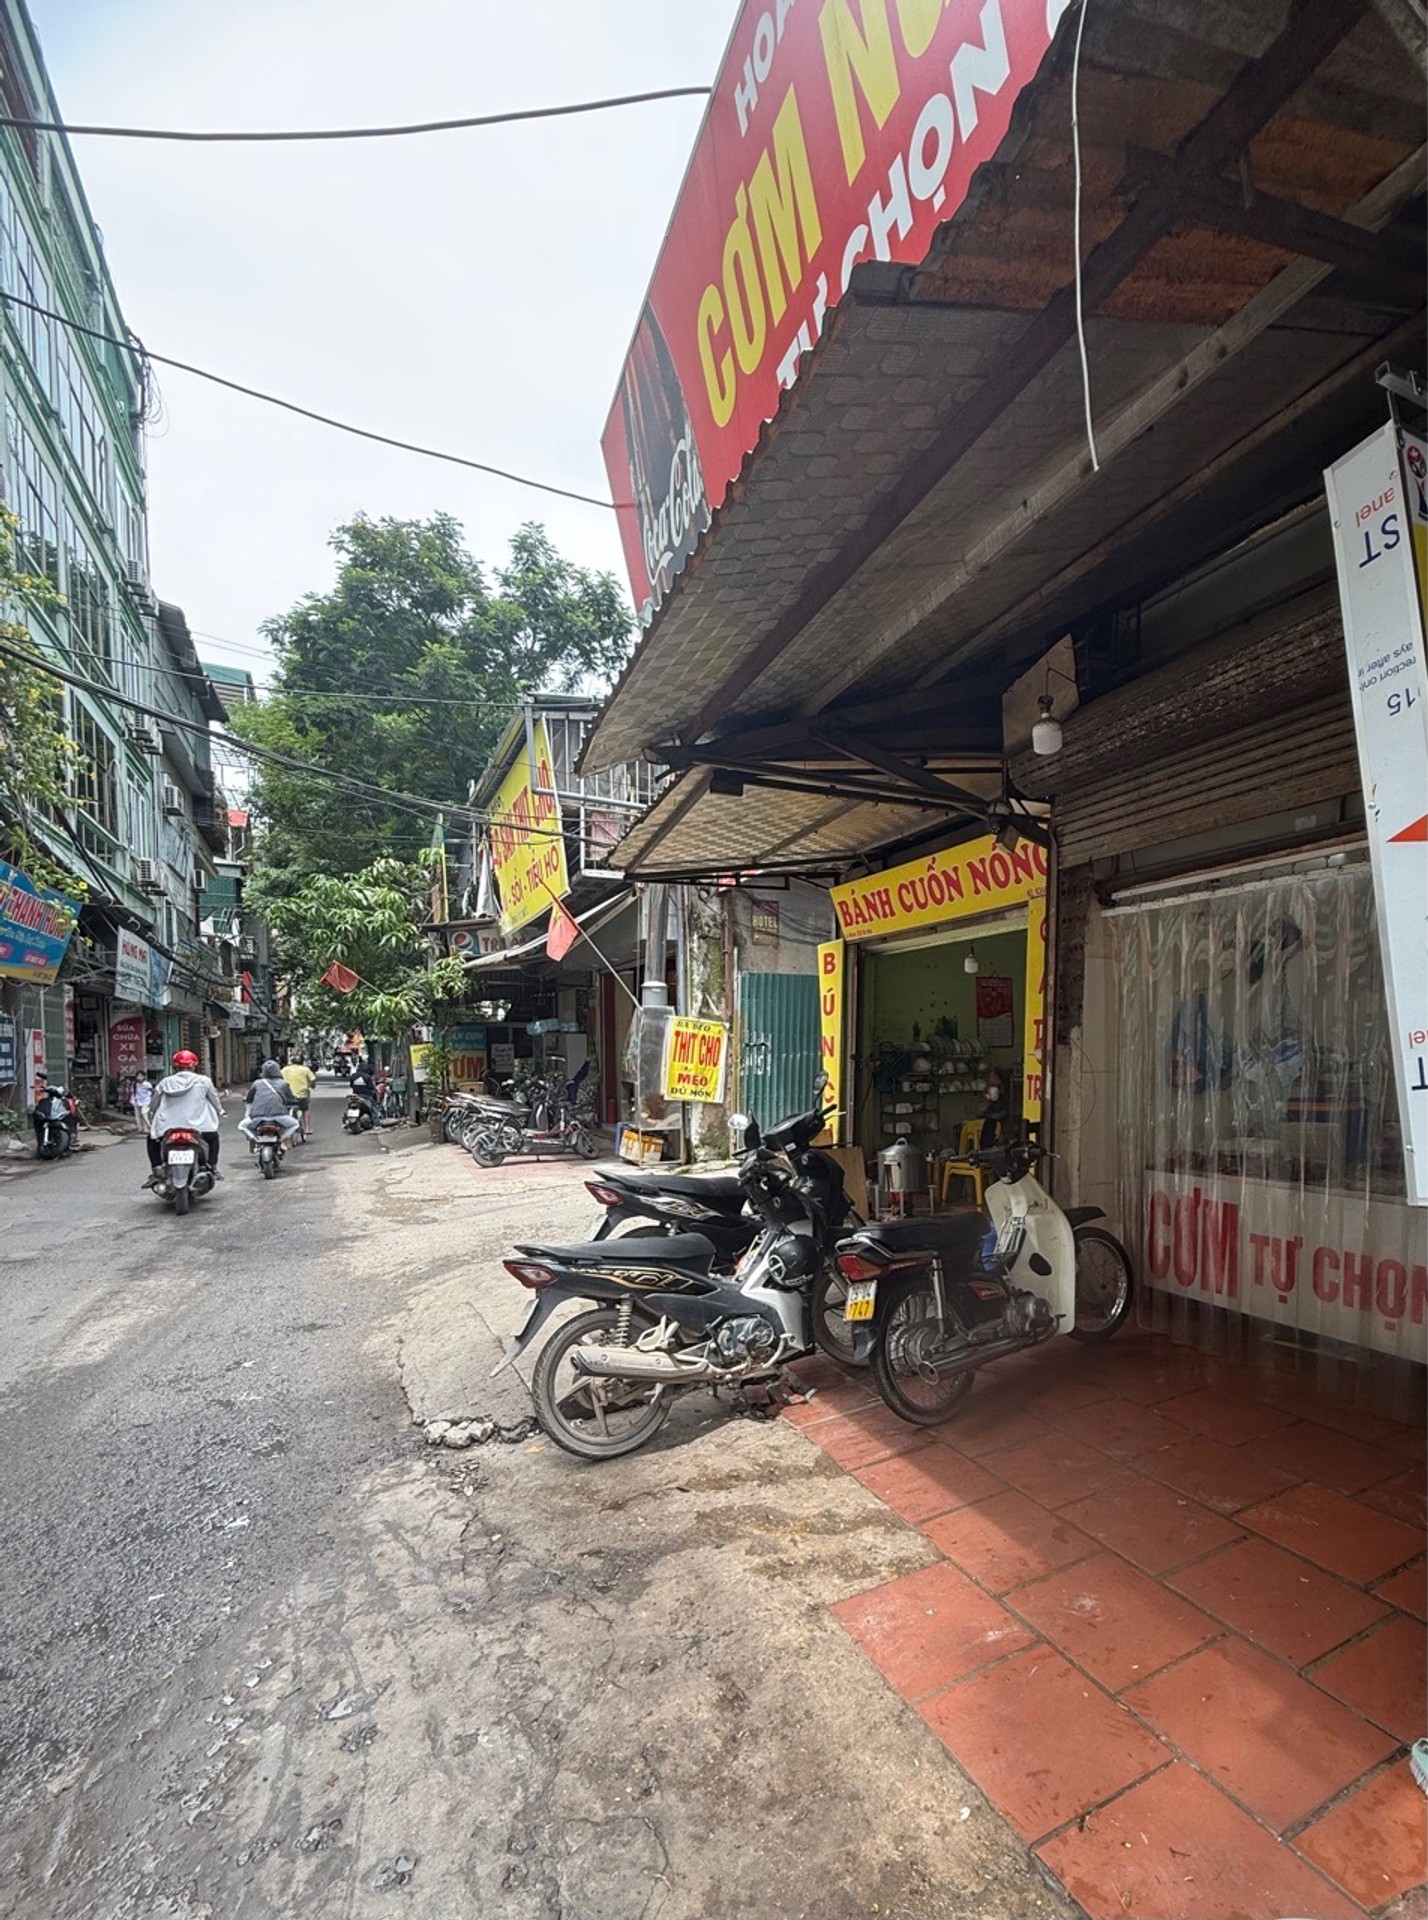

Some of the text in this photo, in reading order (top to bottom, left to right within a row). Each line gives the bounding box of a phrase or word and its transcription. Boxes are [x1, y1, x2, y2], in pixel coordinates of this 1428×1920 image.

[840, 0, 1010, 294] CHỌN
[698, 82, 823, 429] CƠM
[1356, 487, 1395, 528] anel
[1358, 513, 1401, 569] ST
[1367, 654, 1391, 672] after
[1386, 687, 1417, 717] 15
[837, 889, 896, 928] BÁNH
[898, 857, 963, 914] CUỐN
[119, 1042, 136, 1051] XE
[699, 1028, 722, 1067] CHÓ
[1408, 1030, 1428, 1049] el
[1149, 1187, 1240, 1300] CƠM
[1249, 1232, 1304, 1304] TỰ
